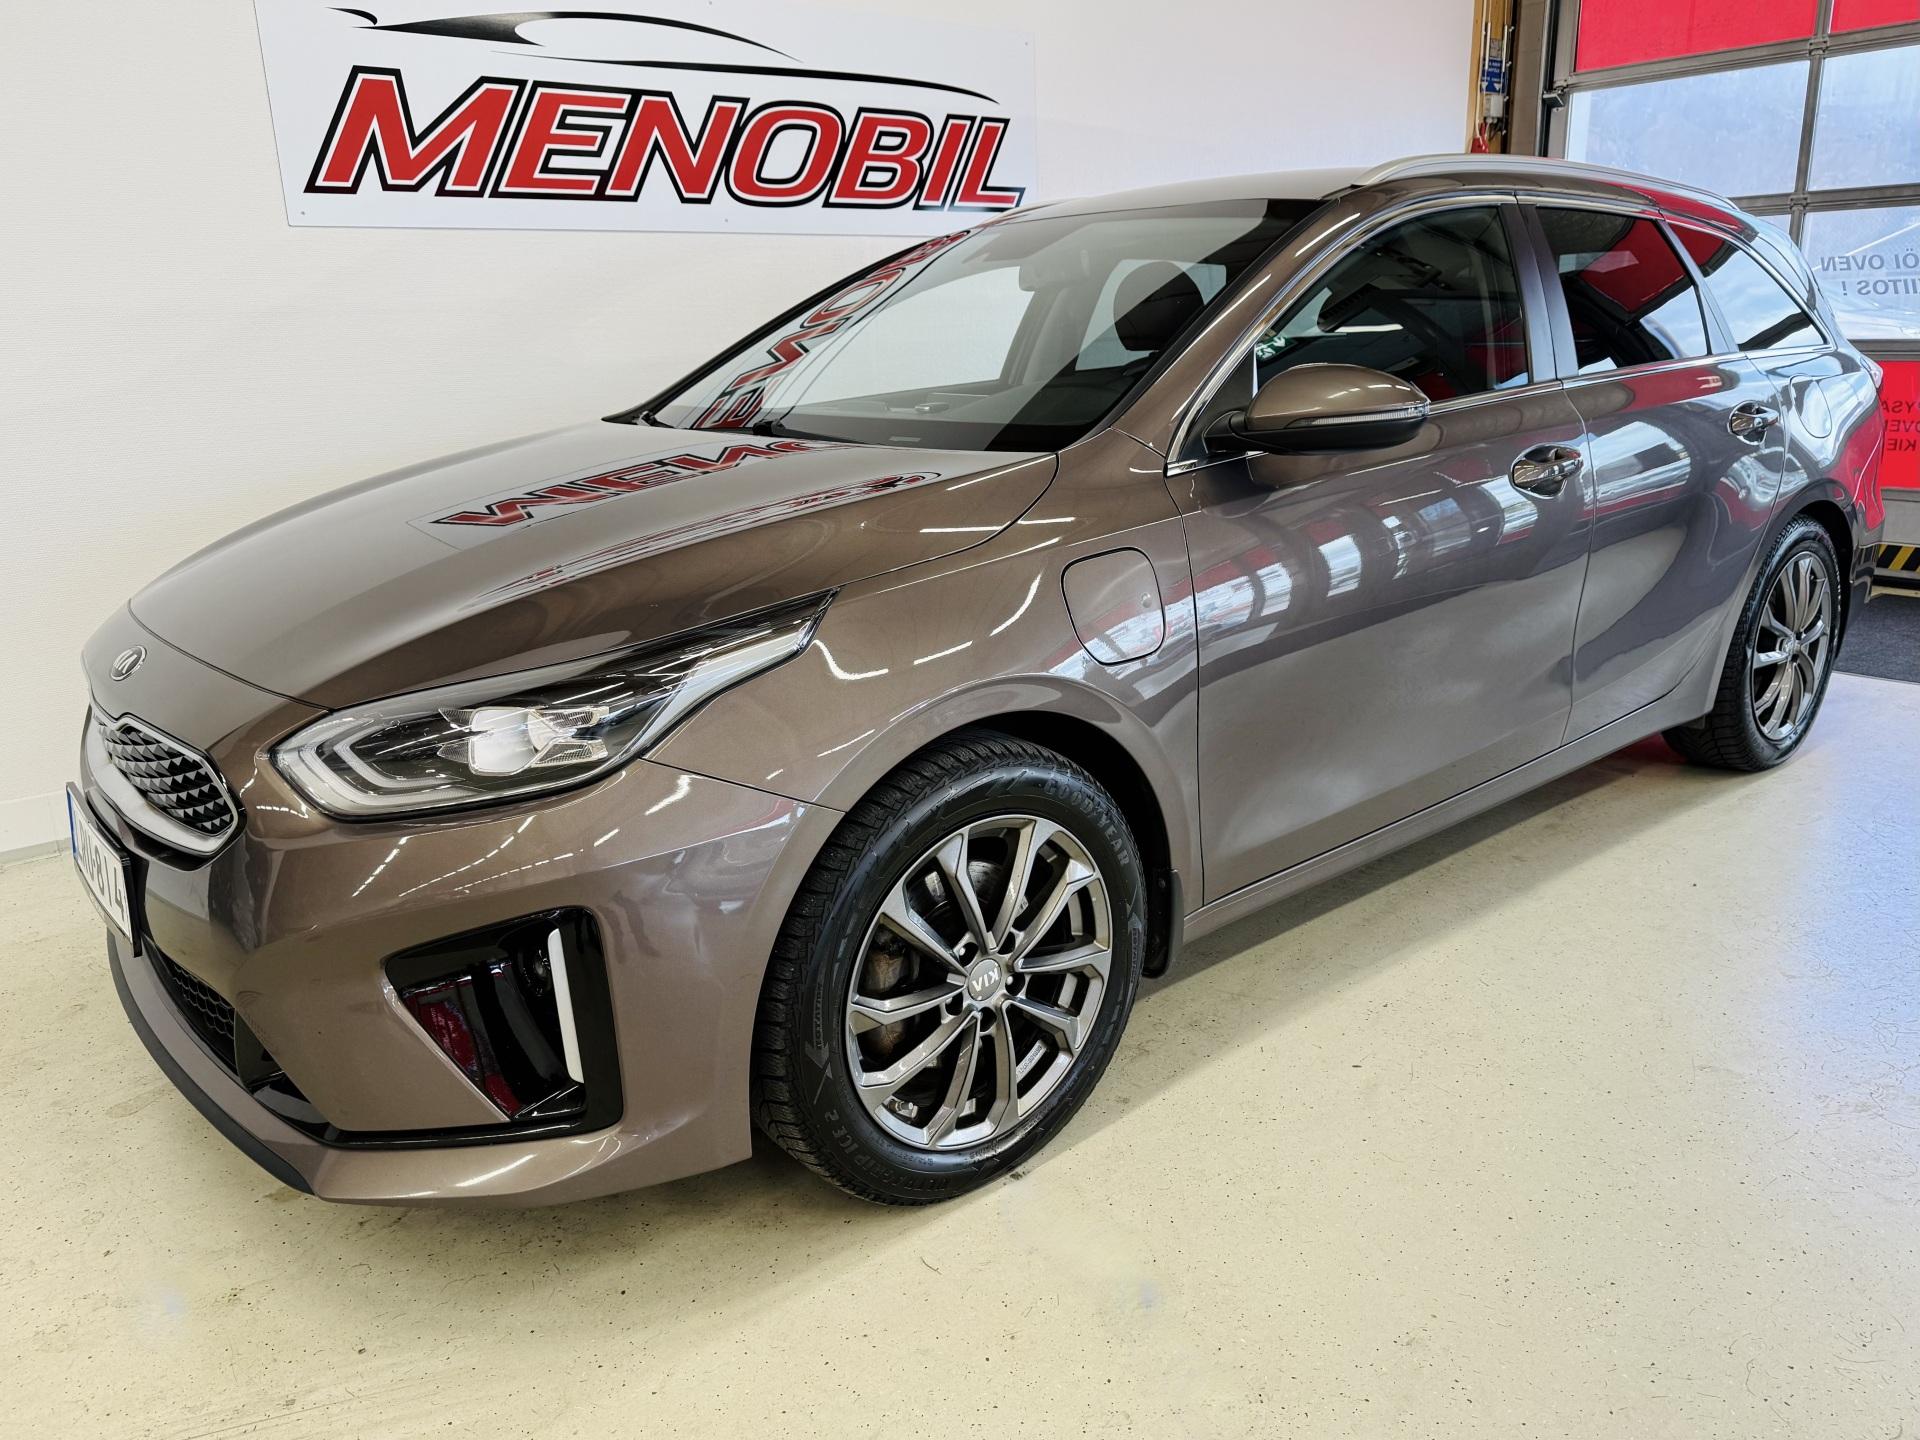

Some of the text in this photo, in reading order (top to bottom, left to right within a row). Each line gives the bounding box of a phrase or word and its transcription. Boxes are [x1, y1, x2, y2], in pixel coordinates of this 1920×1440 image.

[303, 65, 1026, 212] MENOBIL
[1044, 779, 1130, 865] GOODYEAR
[971, 967, 999, 992] KIA
[824, 1109, 840, 1123] 2
[832, 1125, 859, 1154] ICE
